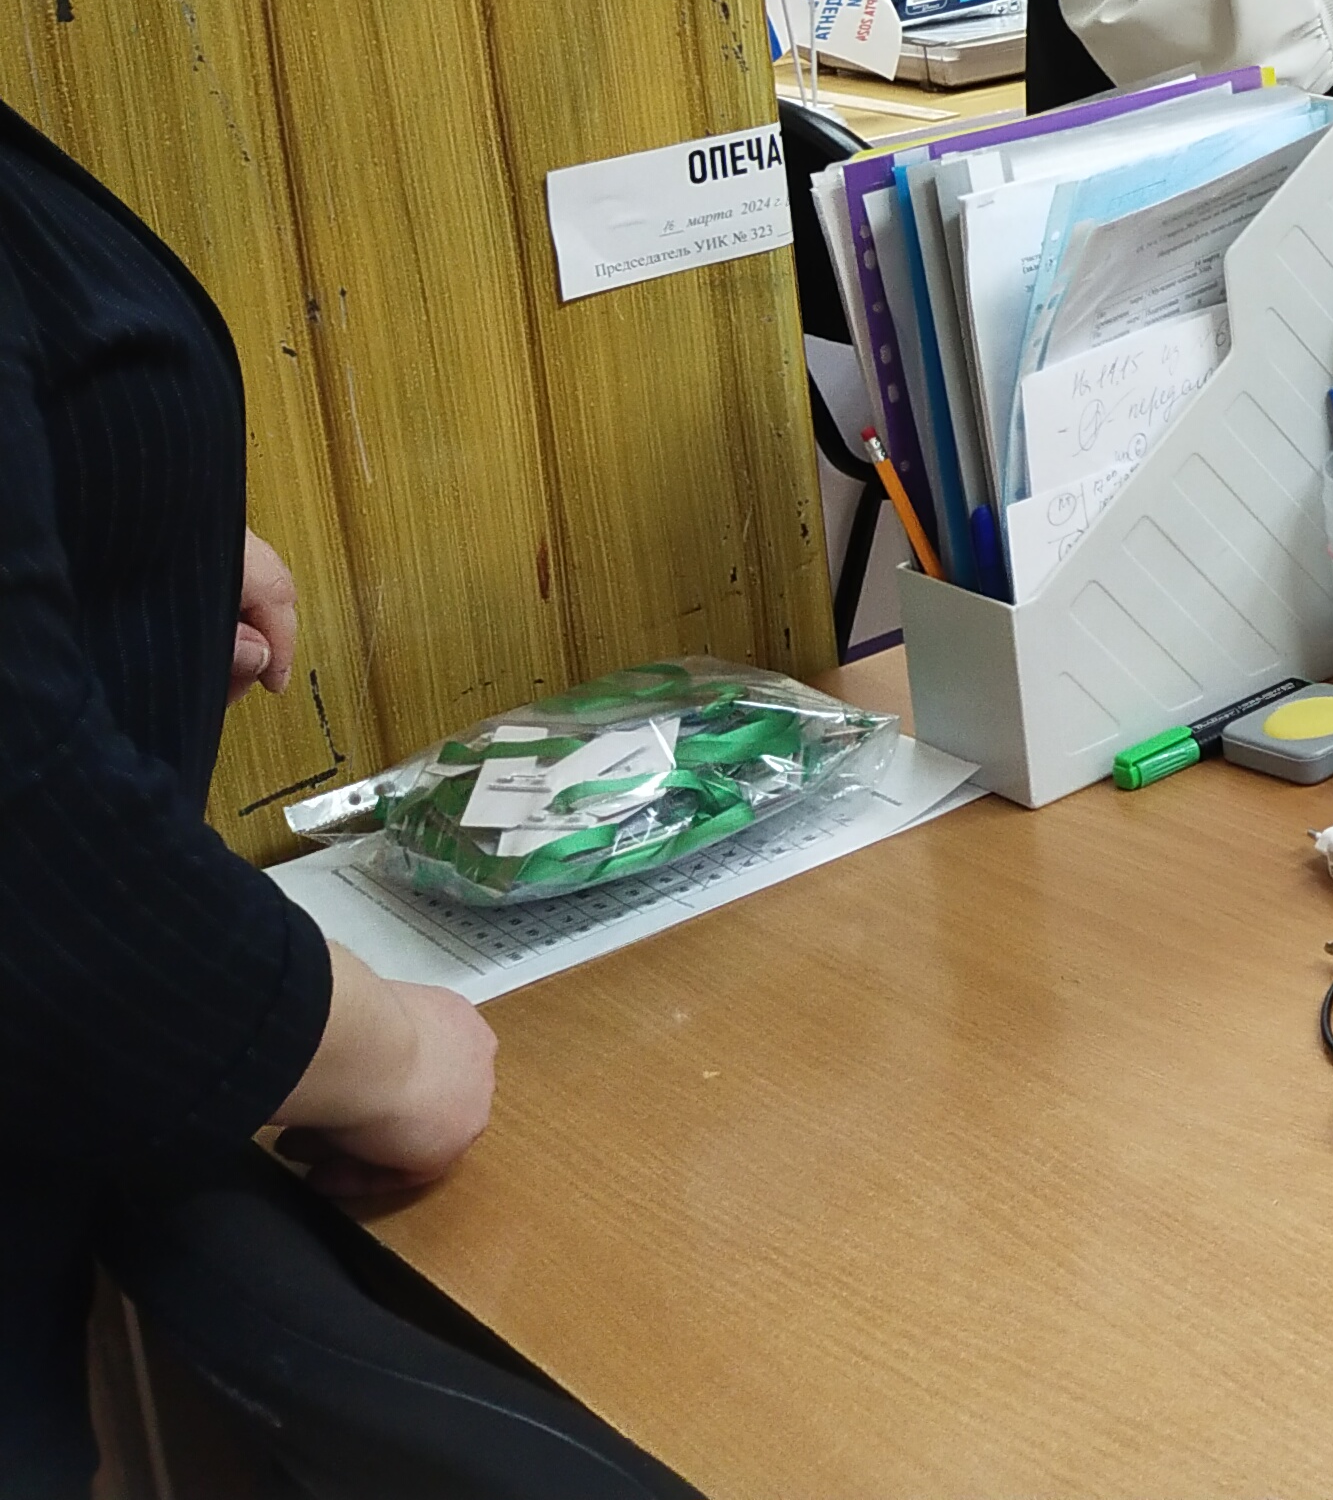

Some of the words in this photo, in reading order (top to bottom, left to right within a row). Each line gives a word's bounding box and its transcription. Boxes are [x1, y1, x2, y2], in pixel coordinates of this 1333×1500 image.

[688, 133, 782, 184] ОПЕЧА
[686, 209, 733, 229] марта
[741, 199, 771, 216] 2024
[595, 248, 690, 277] Председатель
[694, 234, 729, 254] УИК
[731, 229, 748, 245] №
[751, 224, 774, 241] 323
